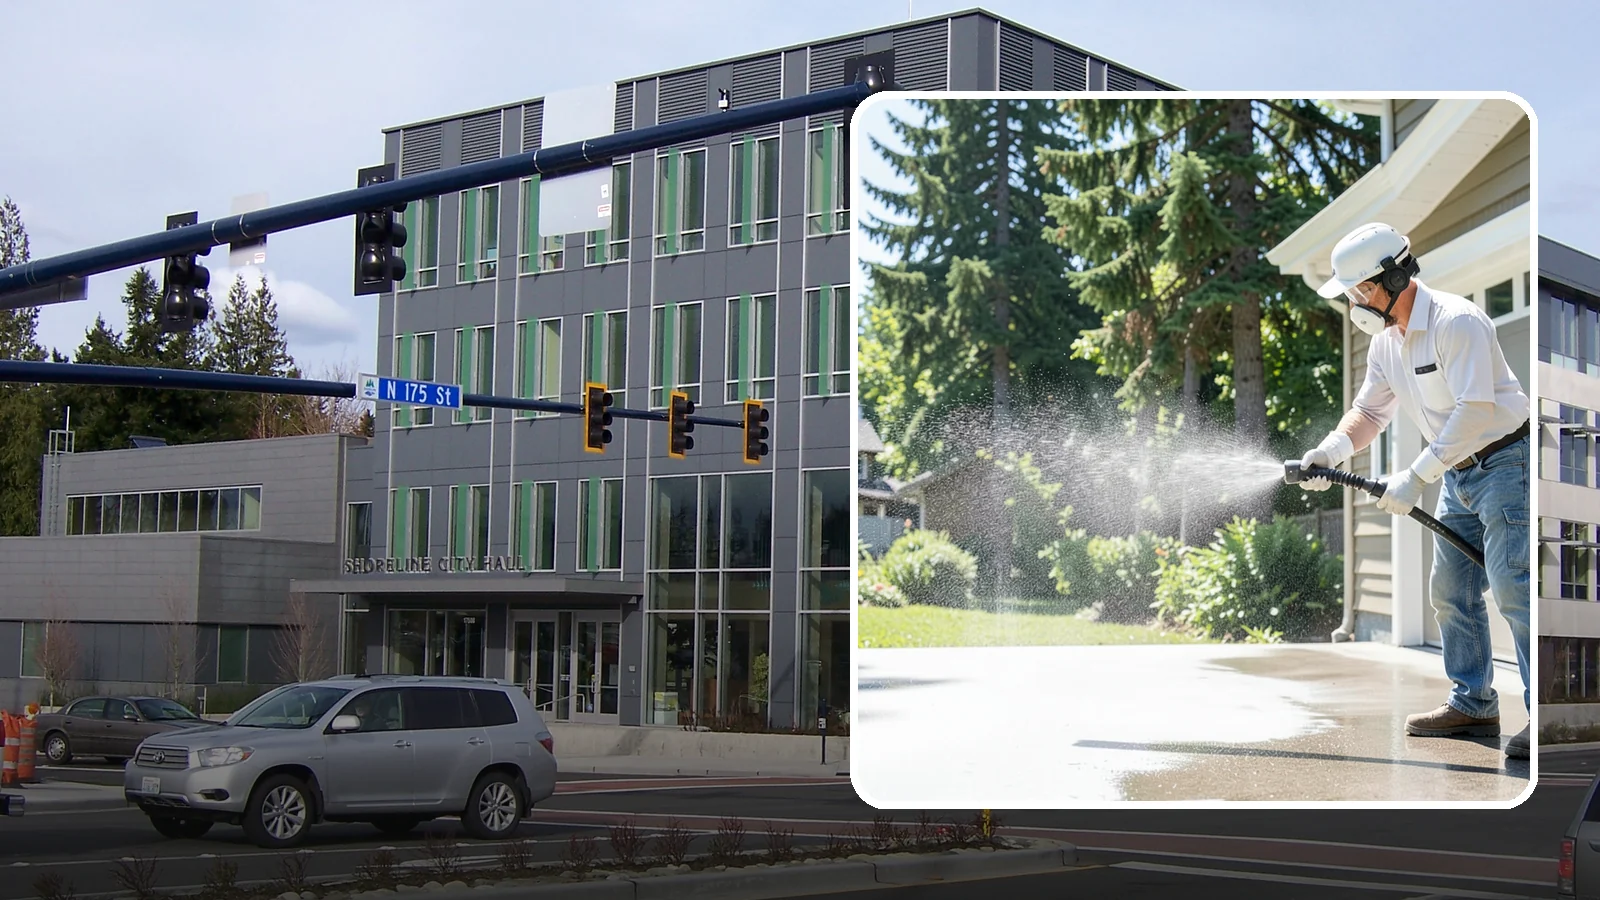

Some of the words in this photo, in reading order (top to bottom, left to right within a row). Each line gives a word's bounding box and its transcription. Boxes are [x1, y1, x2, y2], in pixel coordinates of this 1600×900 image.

[387, 381, 396, 400] N
[405, 383, 428, 403] 175
[436, 387, 451, 406] St
[344, 557, 432, 574] SHORELINE
[438, 556, 476, 572] CITY
[484, 555, 525, 571] HALL
